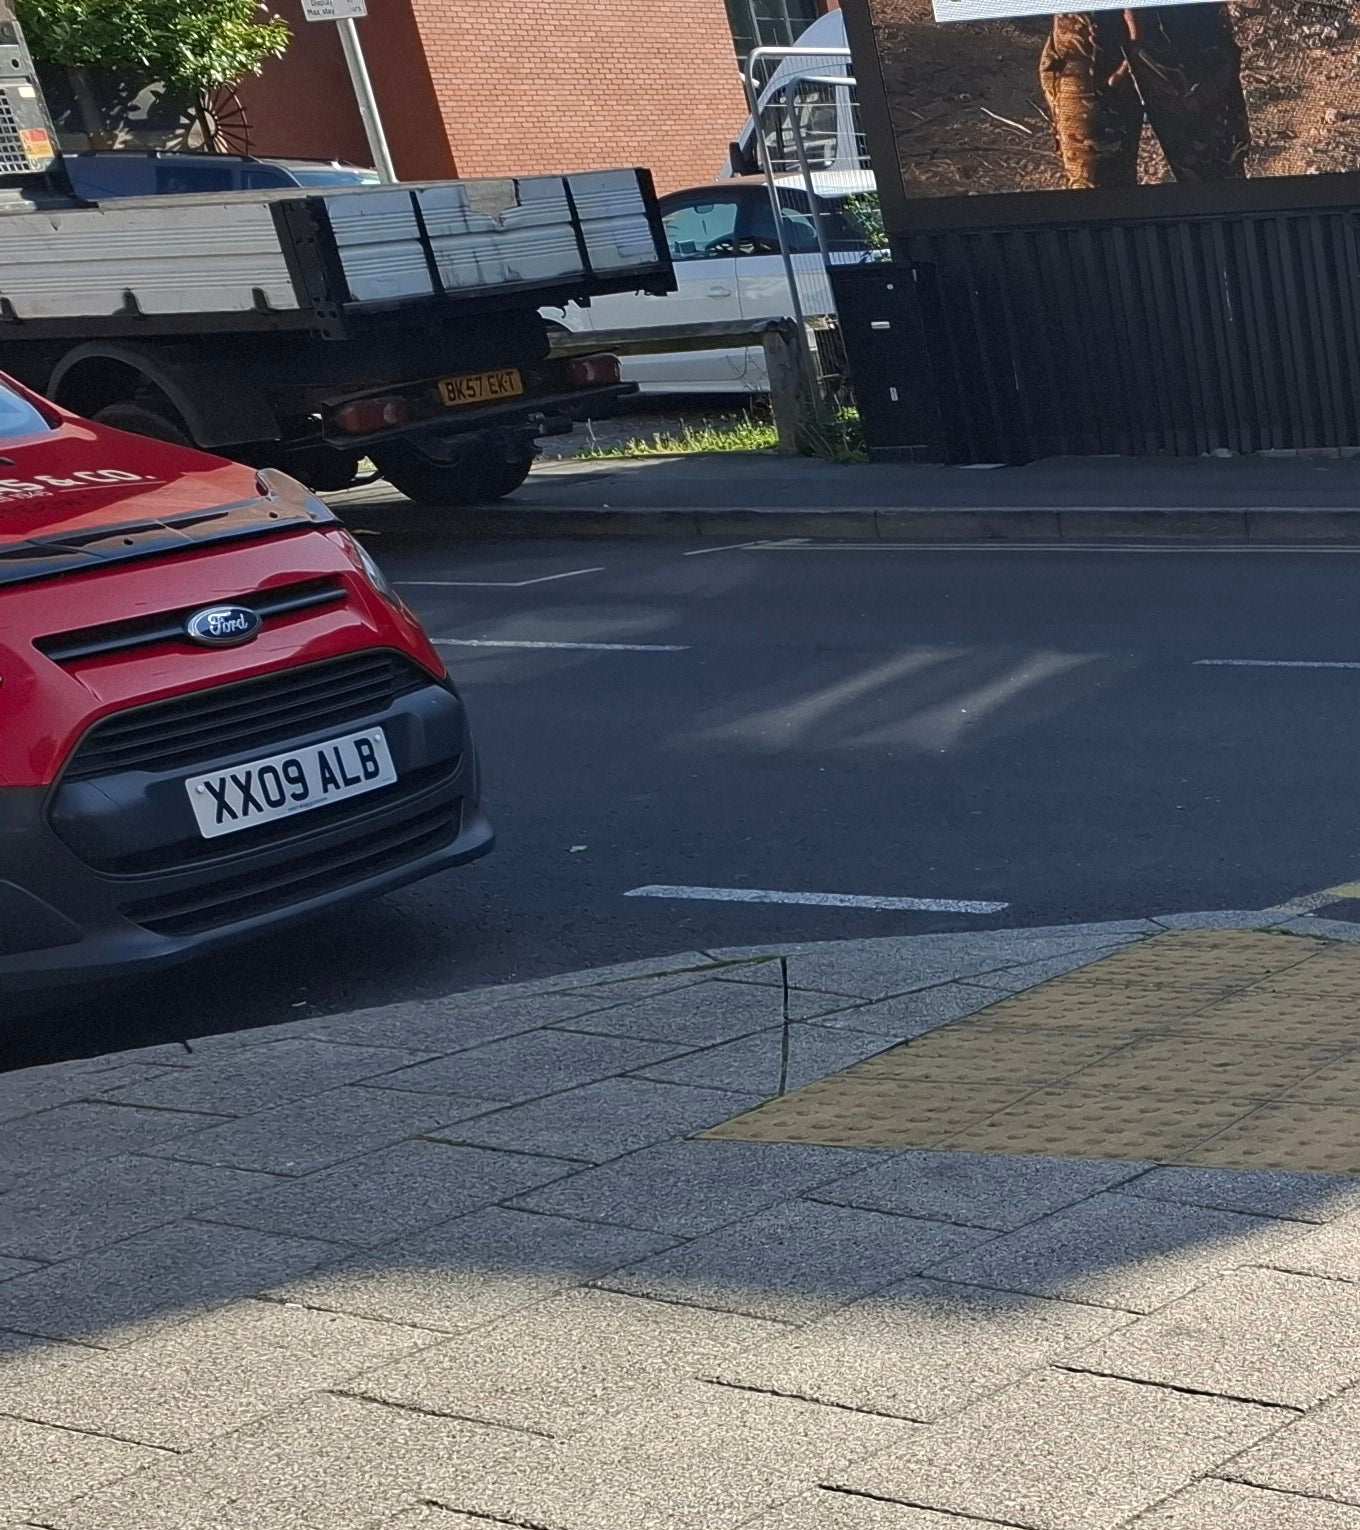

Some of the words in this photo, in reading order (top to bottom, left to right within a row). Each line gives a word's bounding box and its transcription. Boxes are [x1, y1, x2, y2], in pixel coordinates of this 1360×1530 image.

[445, 376, 482, 402] BK57
[208, 610, 249, 636] Ford
[203, 757, 310, 825] XX09
[317, 737, 380, 794] ALB
